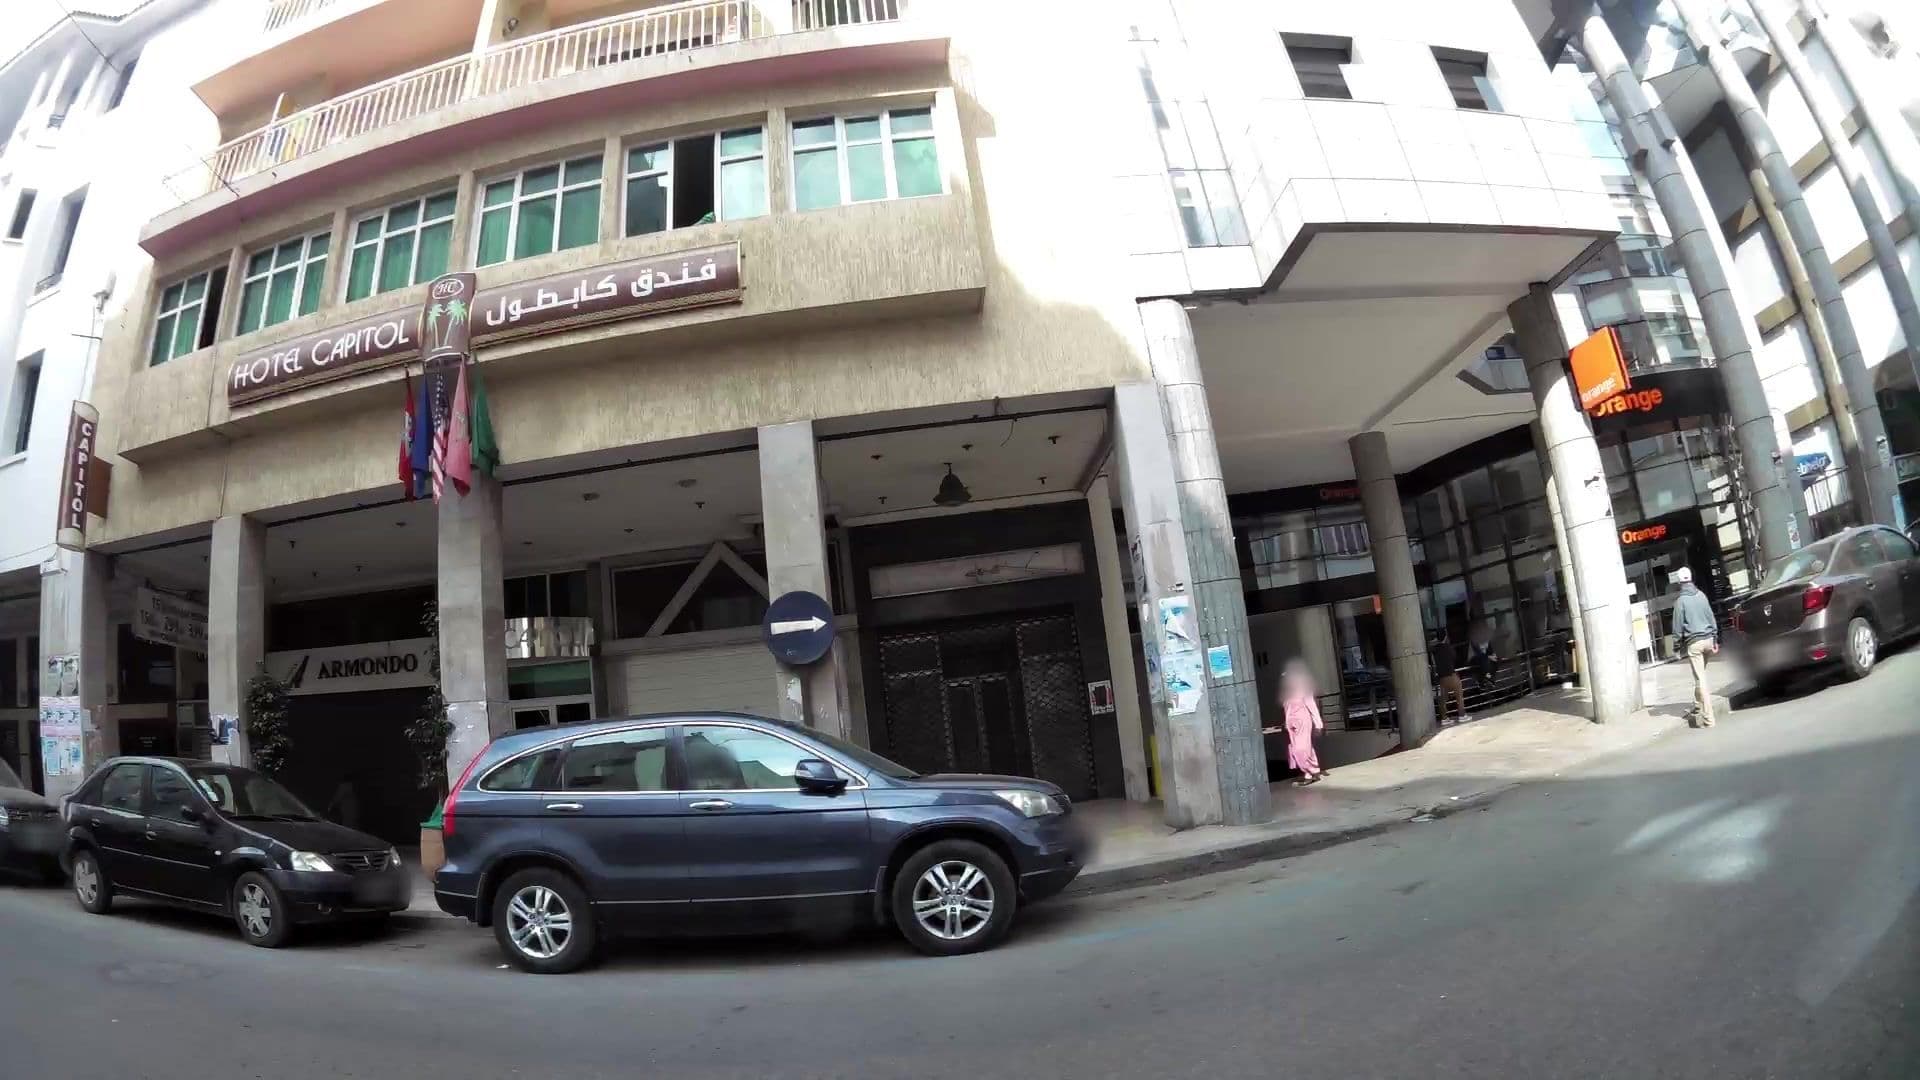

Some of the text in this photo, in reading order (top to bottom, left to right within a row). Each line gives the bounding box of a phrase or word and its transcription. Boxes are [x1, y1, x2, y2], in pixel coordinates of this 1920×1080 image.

[486, 257, 717, 326] فندق كابطول
[234, 319, 410, 389] HOTEL CAPITOL
[1581, 376, 1617, 402] orange
[71, 422, 93, 528] CAPITOL
[1622, 525, 1667, 544] Orange
[317, 653, 419, 680] ARMONDO
